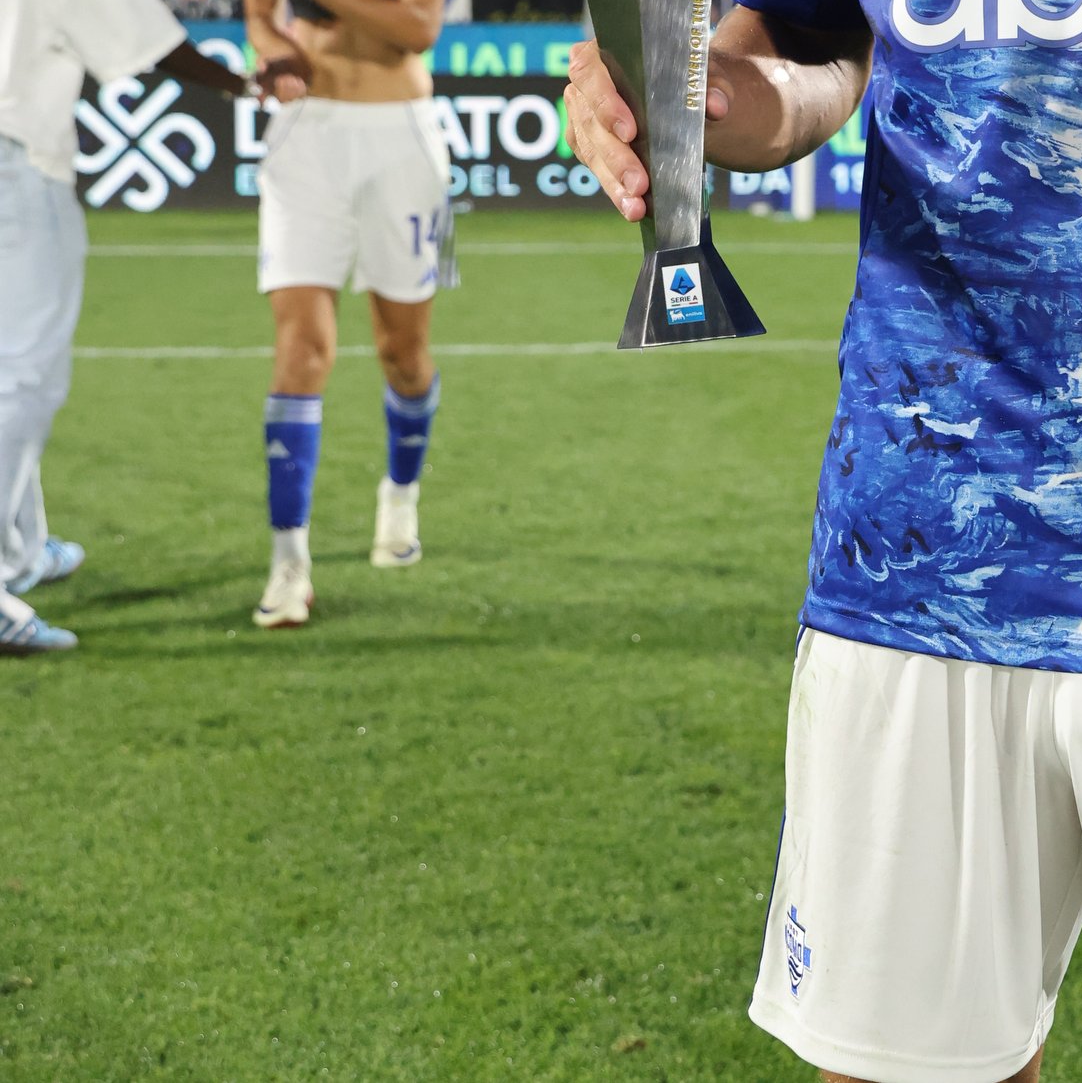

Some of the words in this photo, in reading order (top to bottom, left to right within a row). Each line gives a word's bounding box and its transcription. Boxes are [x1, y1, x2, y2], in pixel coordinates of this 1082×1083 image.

[690, 26, 704, 50] OF
[687, 50, 702, 110] PLAYER
[670, 295, 692, 304] SERIE
